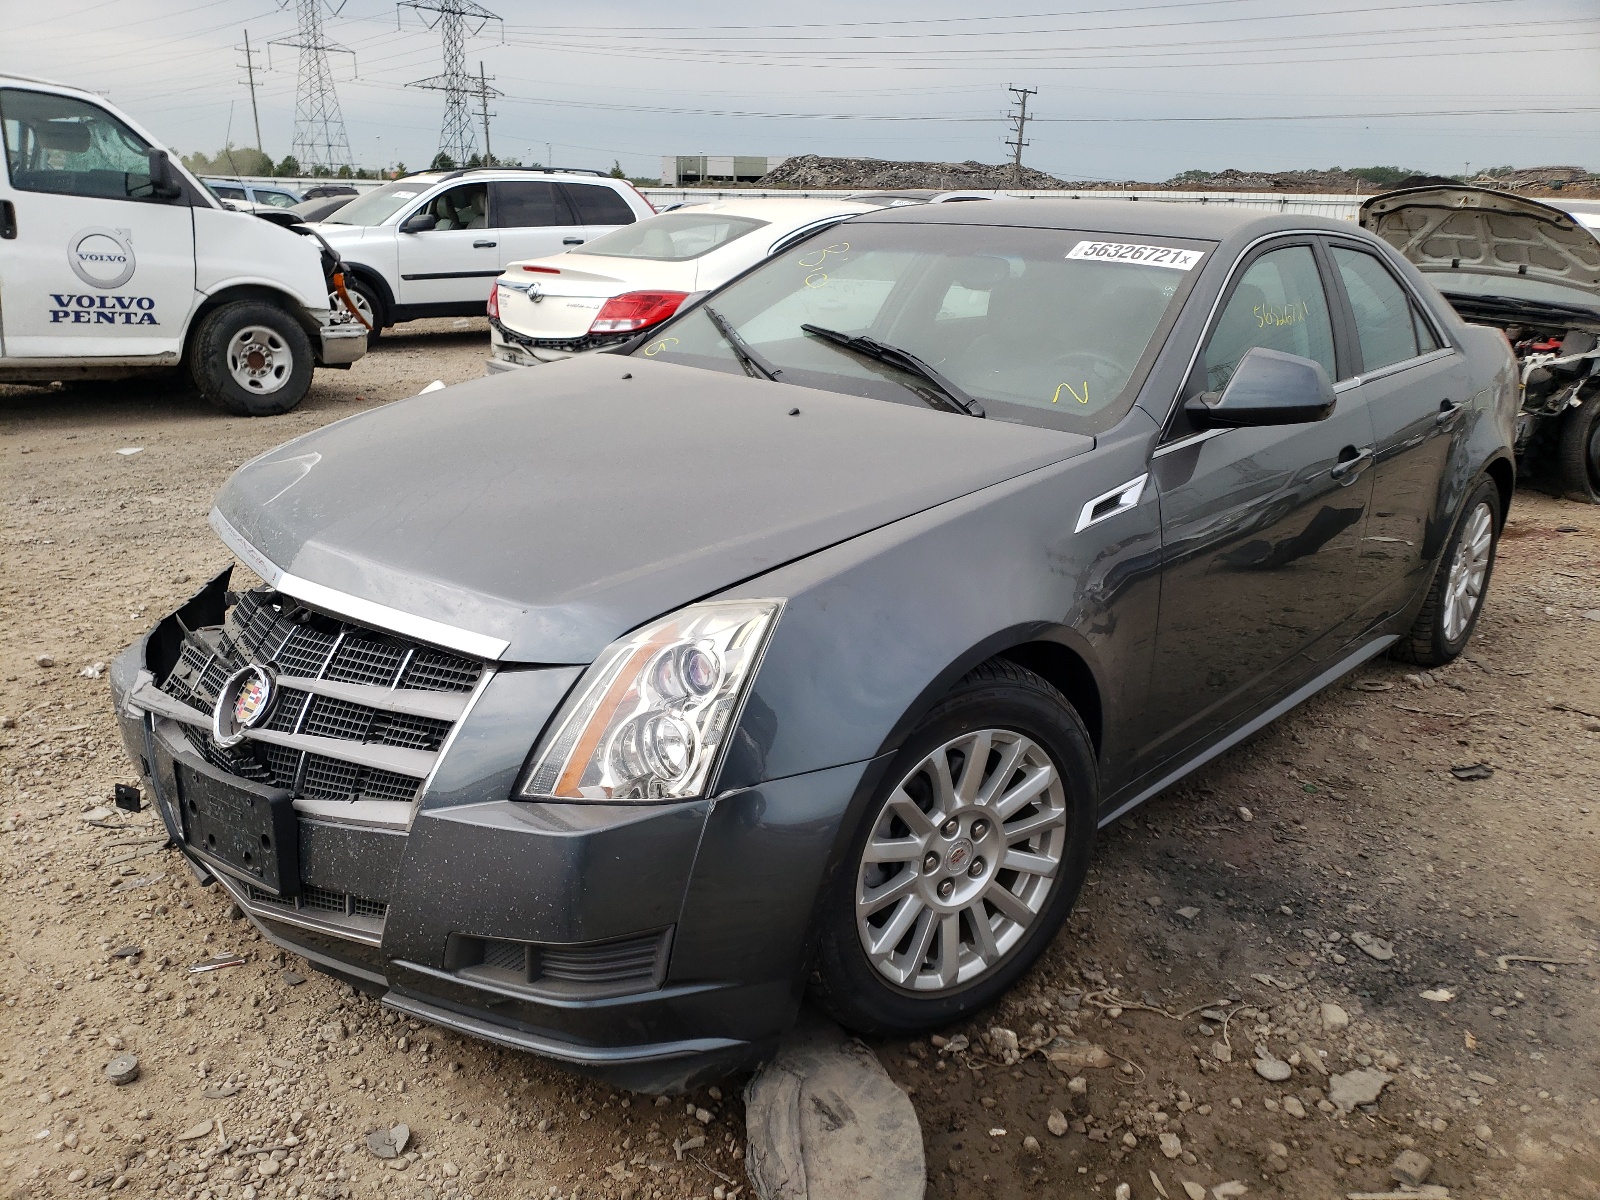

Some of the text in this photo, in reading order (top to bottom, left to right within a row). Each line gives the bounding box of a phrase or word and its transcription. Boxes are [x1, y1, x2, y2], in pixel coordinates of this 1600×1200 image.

[78, 253, 127, 263] VOLVO
[49, 294, 155, 310] VOLVO
[49, 310, 160, 325] PENTA
